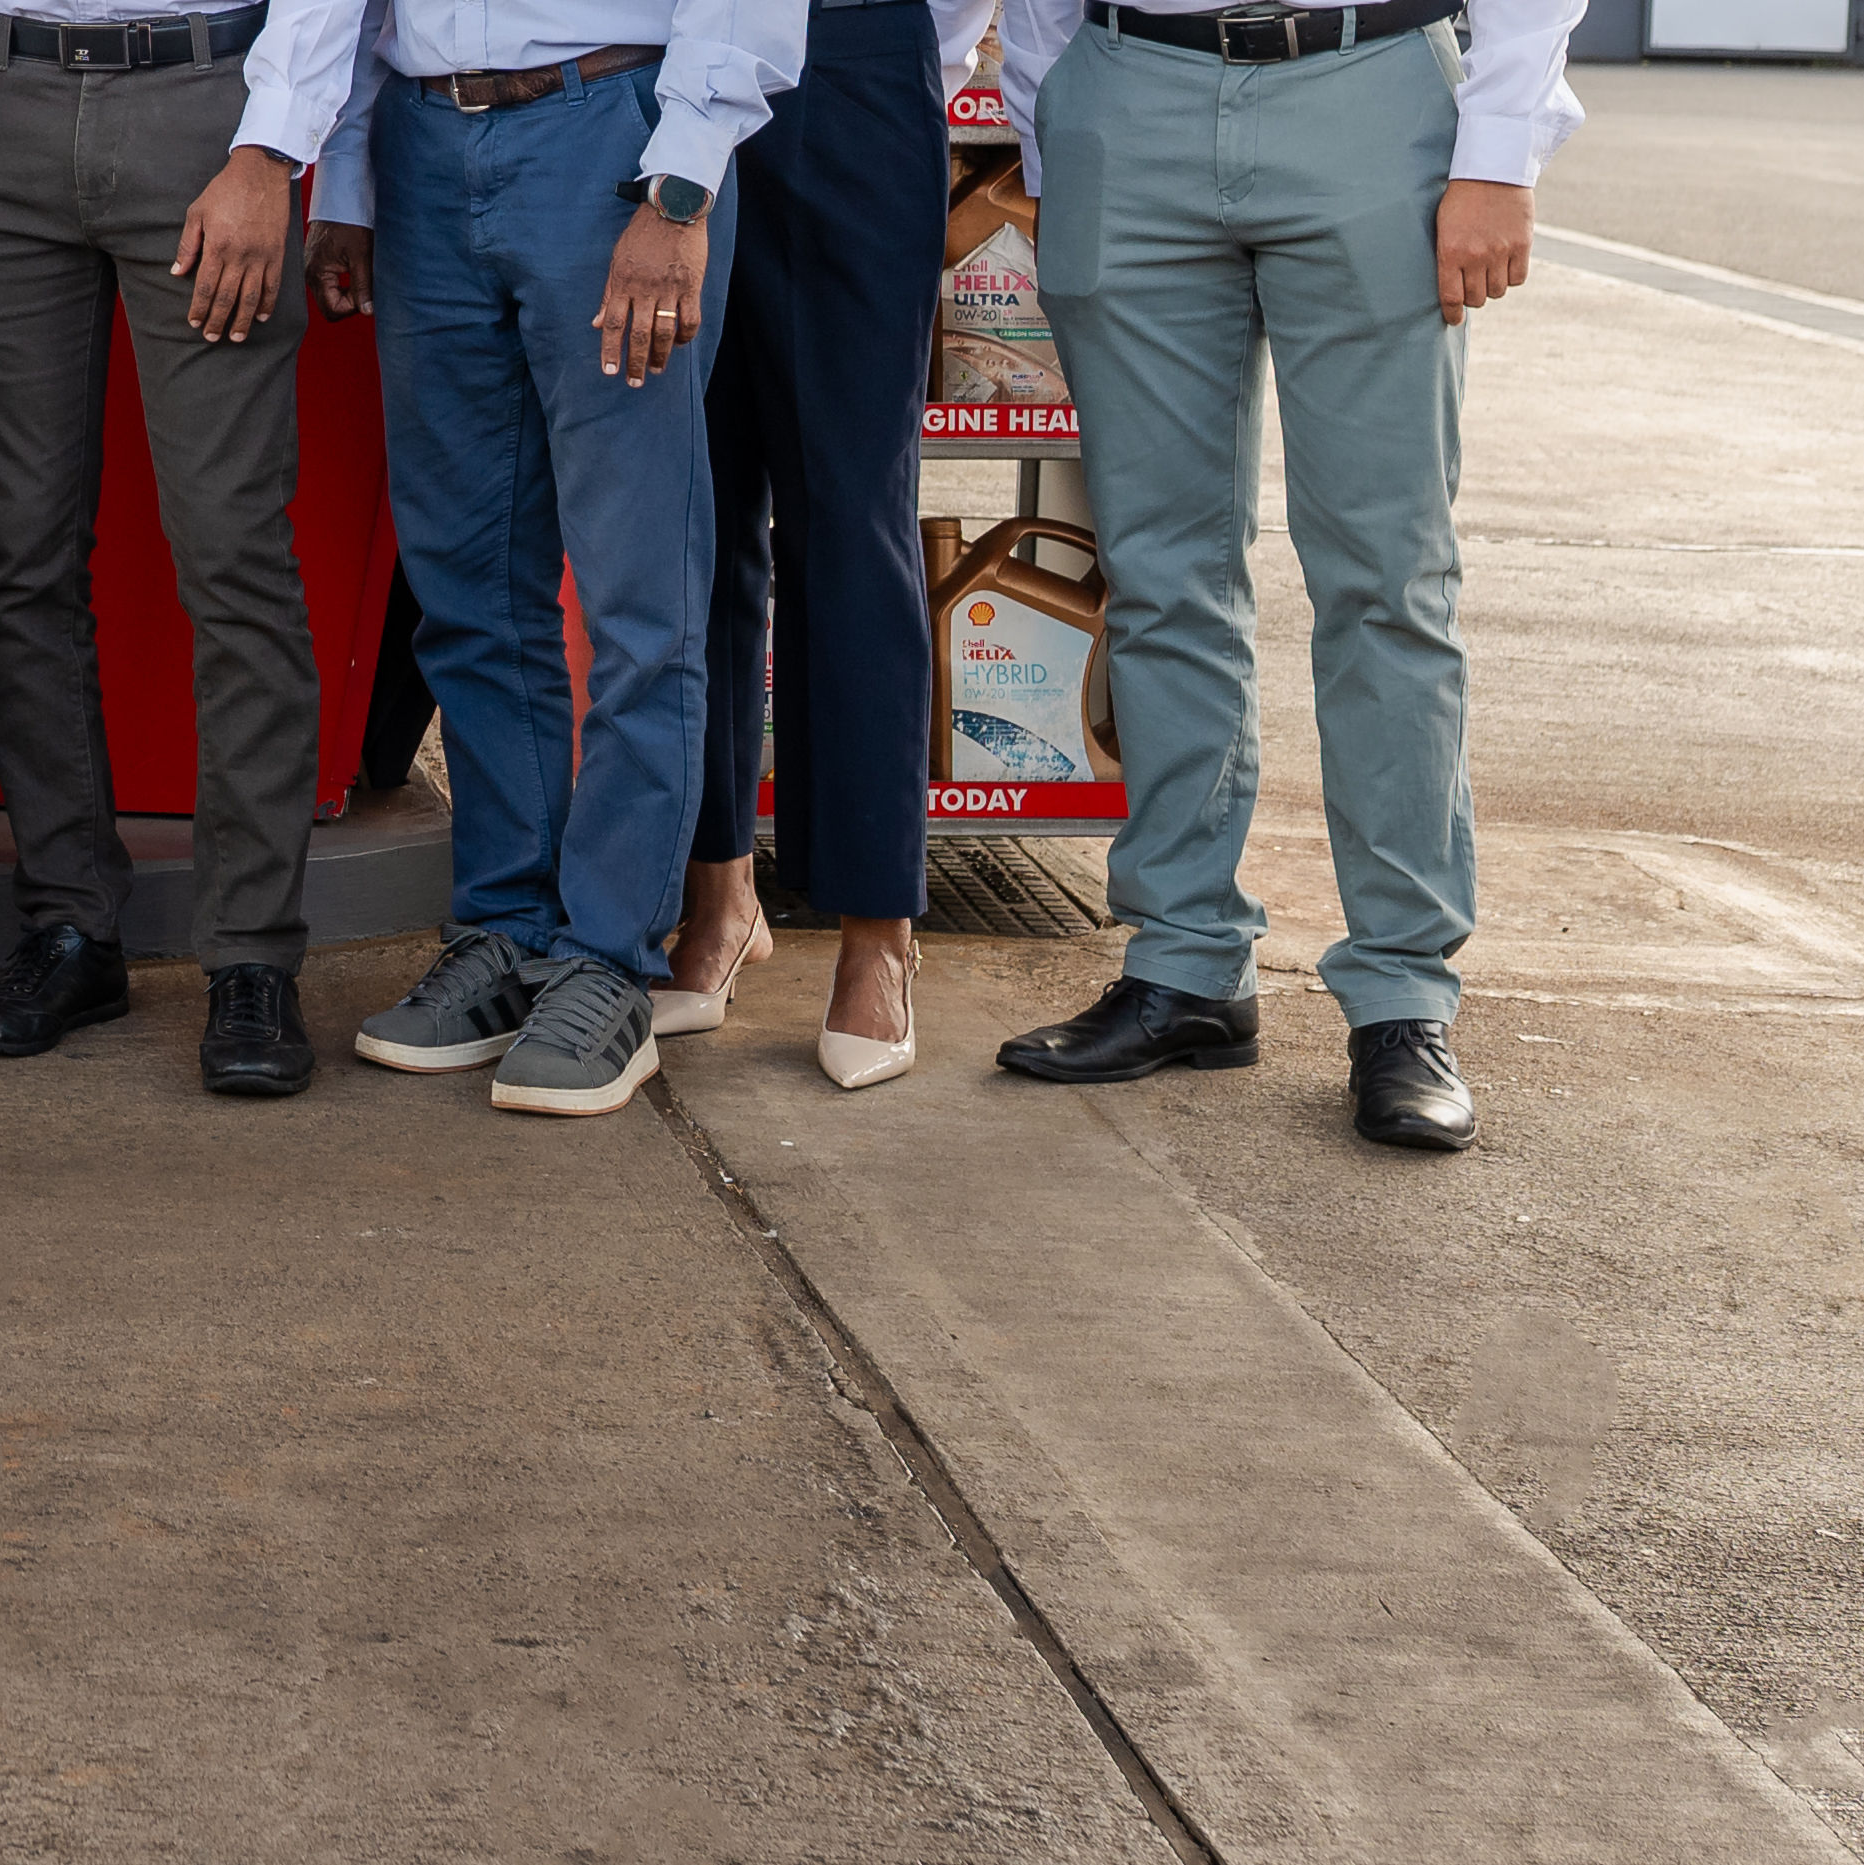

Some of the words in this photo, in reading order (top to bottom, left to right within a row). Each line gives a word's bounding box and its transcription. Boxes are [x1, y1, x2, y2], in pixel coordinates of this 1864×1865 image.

[953, 275, 1033, 291] HELIX
[954, 294, 1020, 306] ULTRA
[954, 309, 997, 322] 0W-20
[923, 408, 998, 432] GINE
[962, 649, 1015, 660] HELIX
[963, 664, 1047, 685] HYBRID
[927, 788, 1028, 811] TODAY
